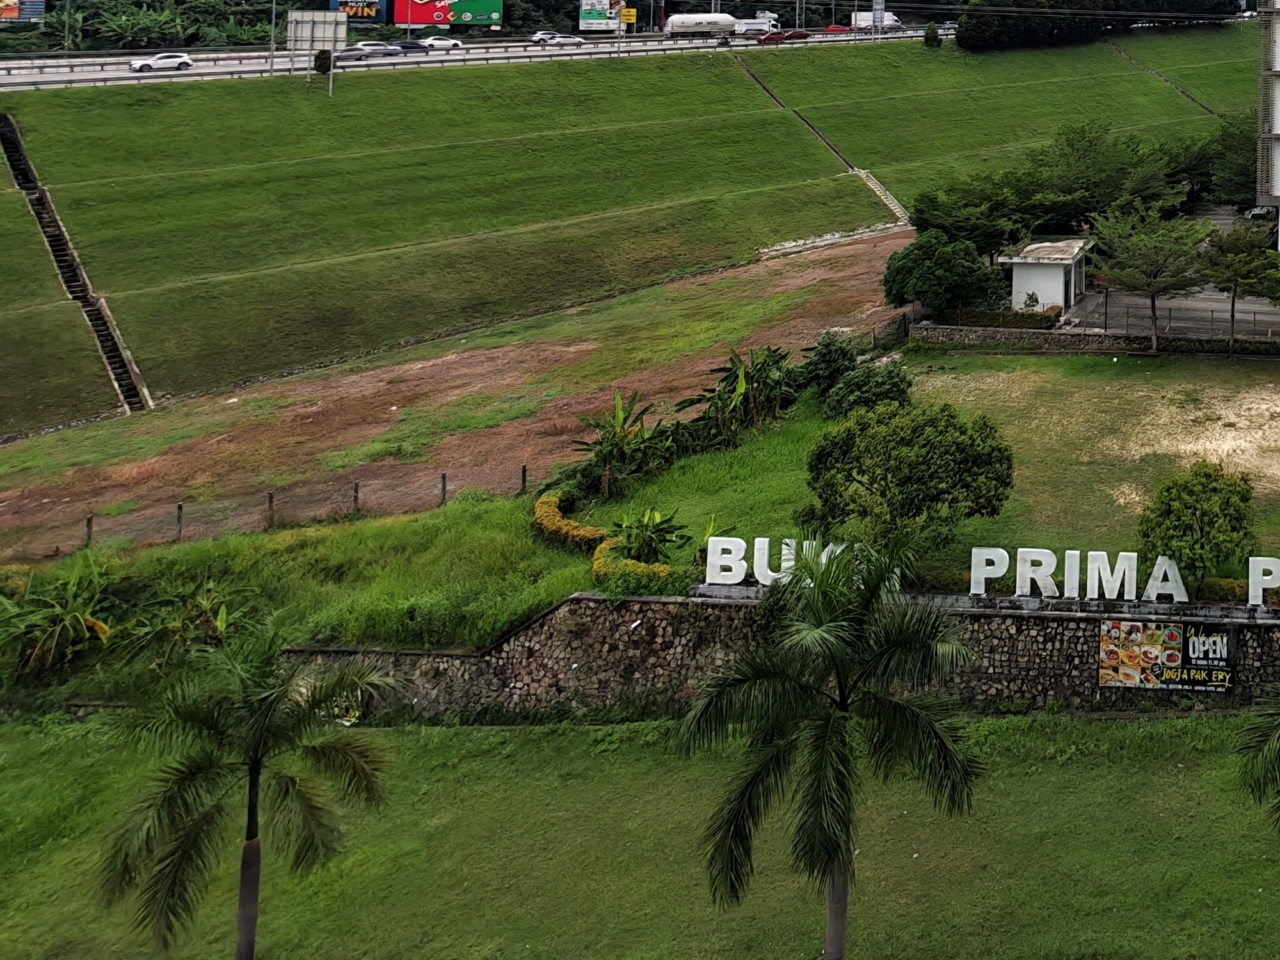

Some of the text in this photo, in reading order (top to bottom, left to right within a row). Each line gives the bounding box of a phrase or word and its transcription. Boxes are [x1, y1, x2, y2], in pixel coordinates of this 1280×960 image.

[338, 6, 378, 17] WIN
[969, 546, 1190, 602] PRIMA
[1189, 636, 1228, 658] OPEN
[1161, 668, 1232, 687] JOGJA PAK ERY
